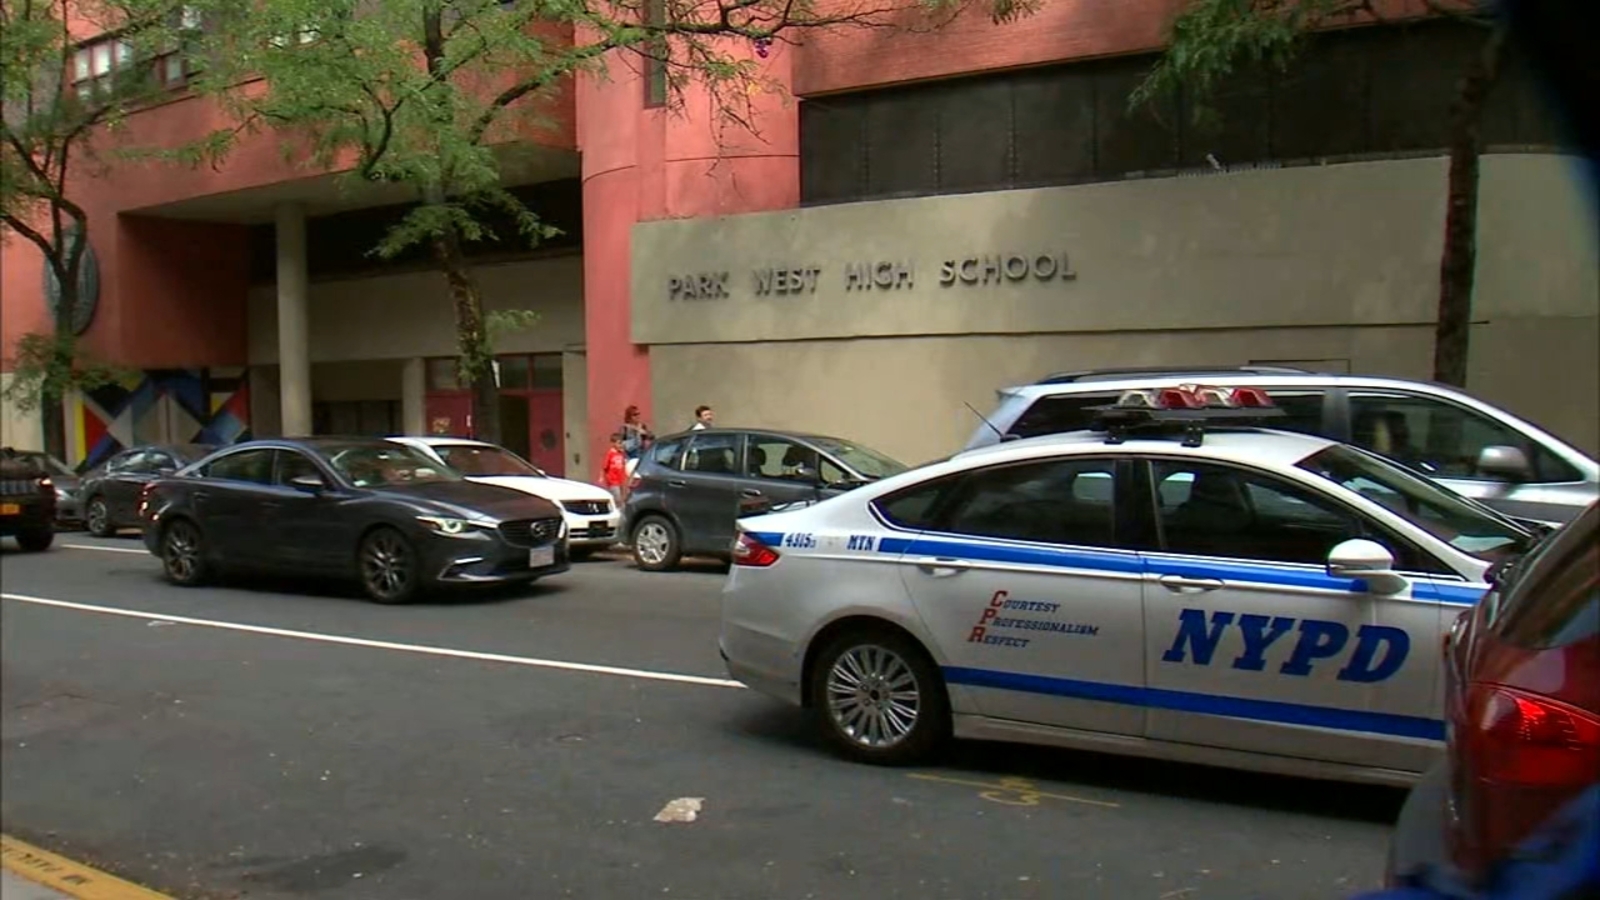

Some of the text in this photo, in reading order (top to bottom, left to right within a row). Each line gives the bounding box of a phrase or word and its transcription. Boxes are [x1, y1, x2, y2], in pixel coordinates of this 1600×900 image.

[668, 252, 1077, 301] PARK WEST HIGH SCHOOL
[990, 590, 1061, 613] COURTESY
[979, 608, 1099, 636] PROFESSIONALISM
[968, 626, 1030, 648] RESPECT
[1162, 608, 1411, 683] NYPD
